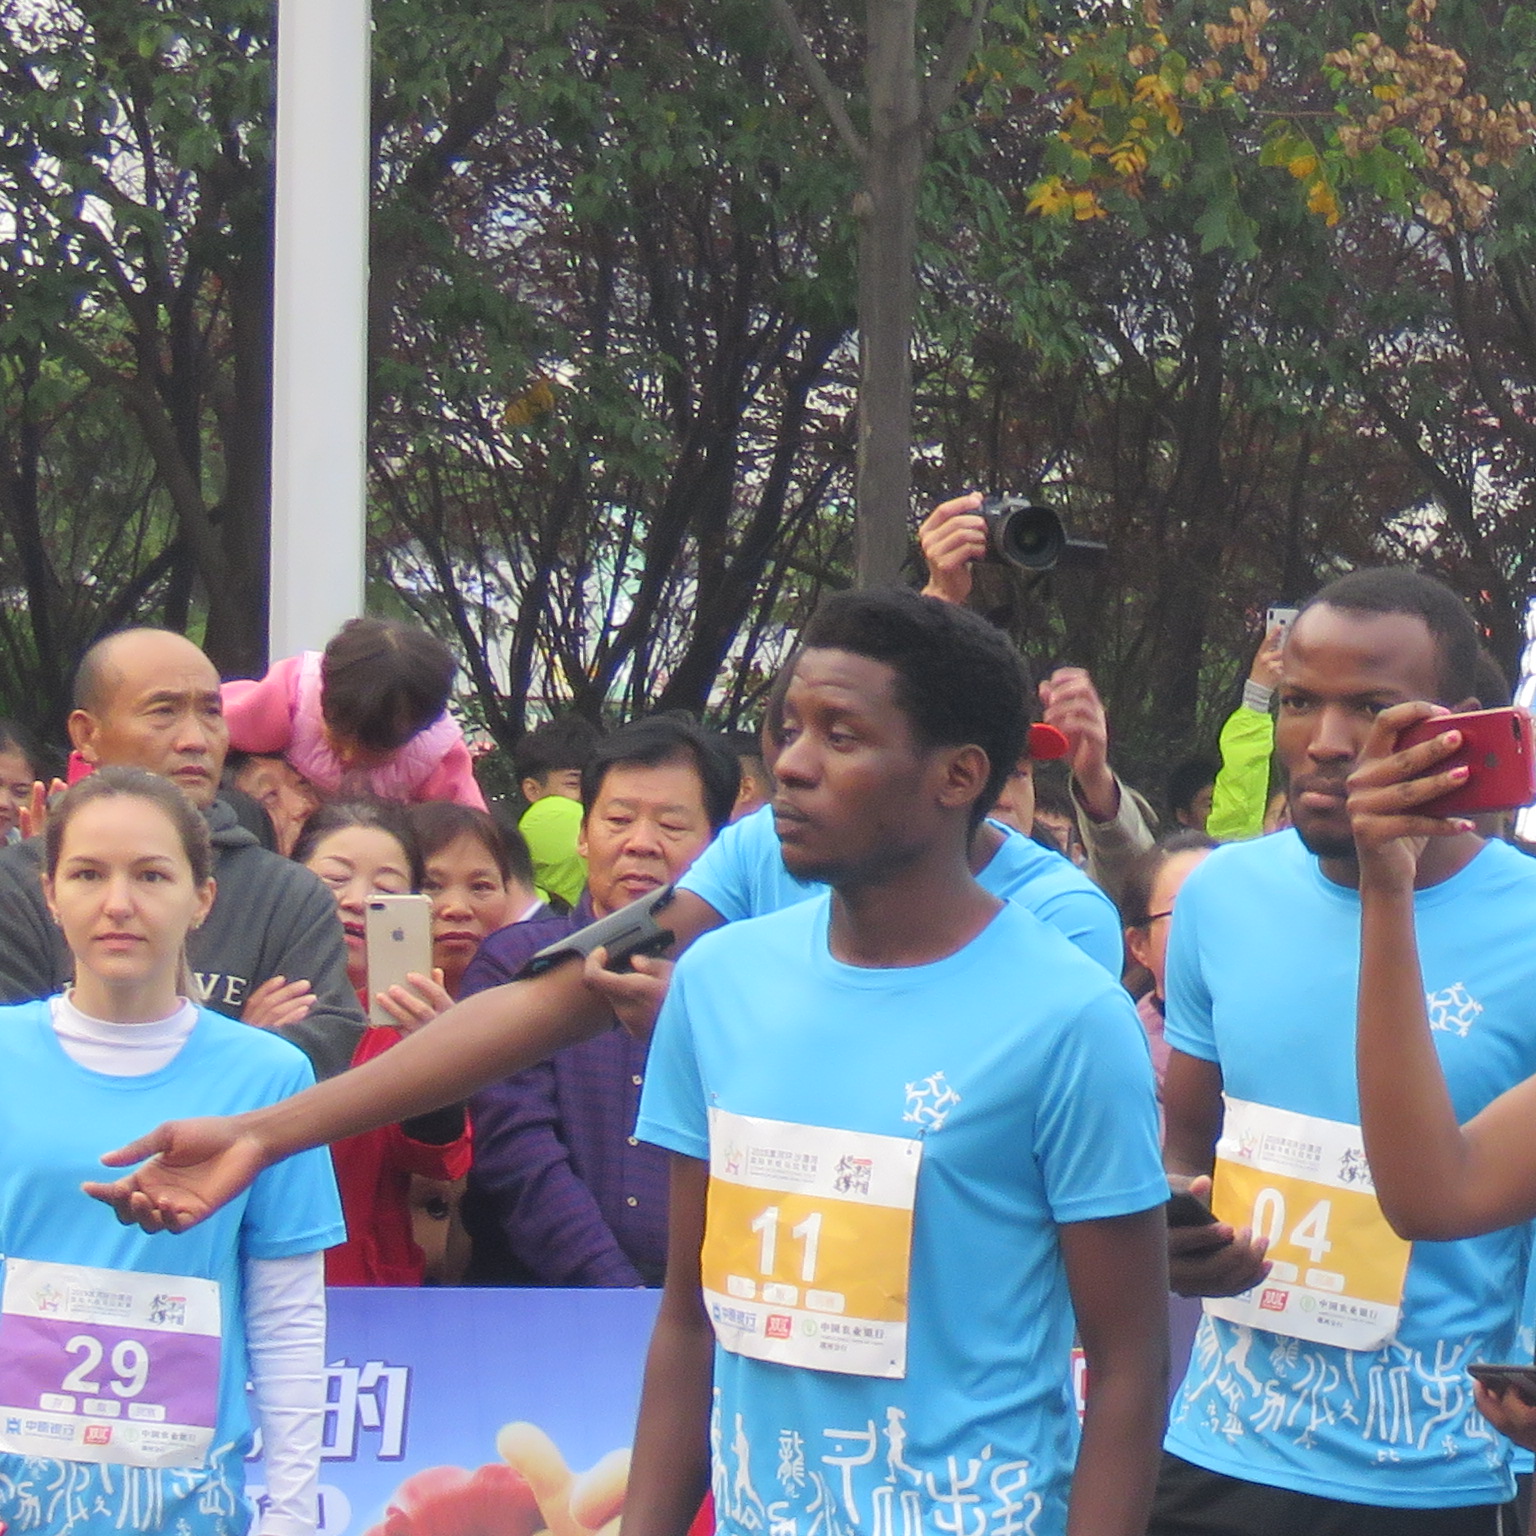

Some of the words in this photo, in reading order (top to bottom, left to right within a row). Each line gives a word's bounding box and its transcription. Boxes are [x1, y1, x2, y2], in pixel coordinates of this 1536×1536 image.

[752, 1206, 822, 1282] 11
[1252, 1187, 1332, 1263] 04
[61, 1335, 149, 1398] 29
